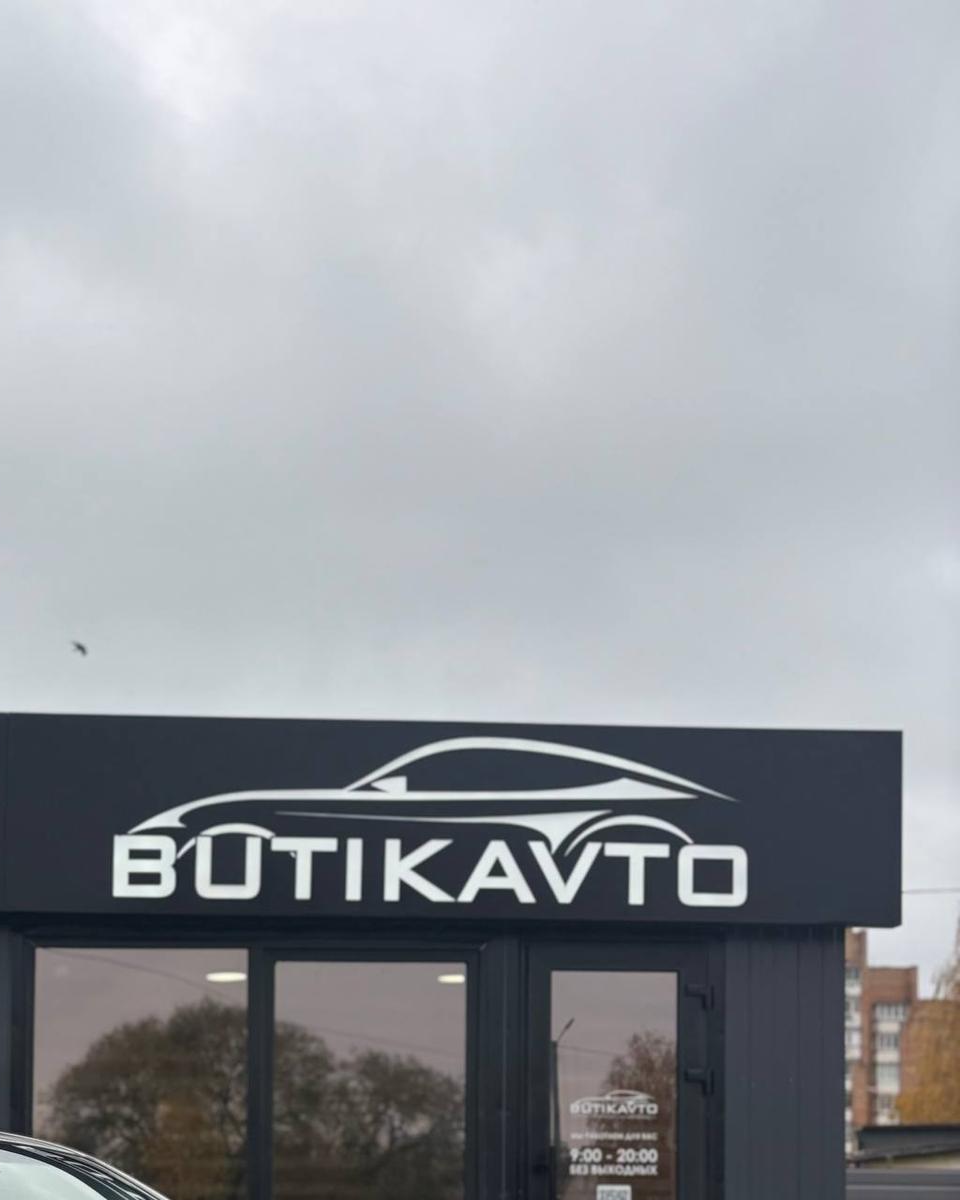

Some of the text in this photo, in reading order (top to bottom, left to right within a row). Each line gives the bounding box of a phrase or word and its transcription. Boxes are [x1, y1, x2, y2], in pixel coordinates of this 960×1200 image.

[111, 833, 748, 907] BUTIKAVTO
[569, 1102, 658, 1115] BUTIKAVTO
[569, 1147, 603, 1163] 9:00
[616, 1147, 658, 1163] 20:00
[591, 1164, 658, 1176] ВЫХОДНЫХ
